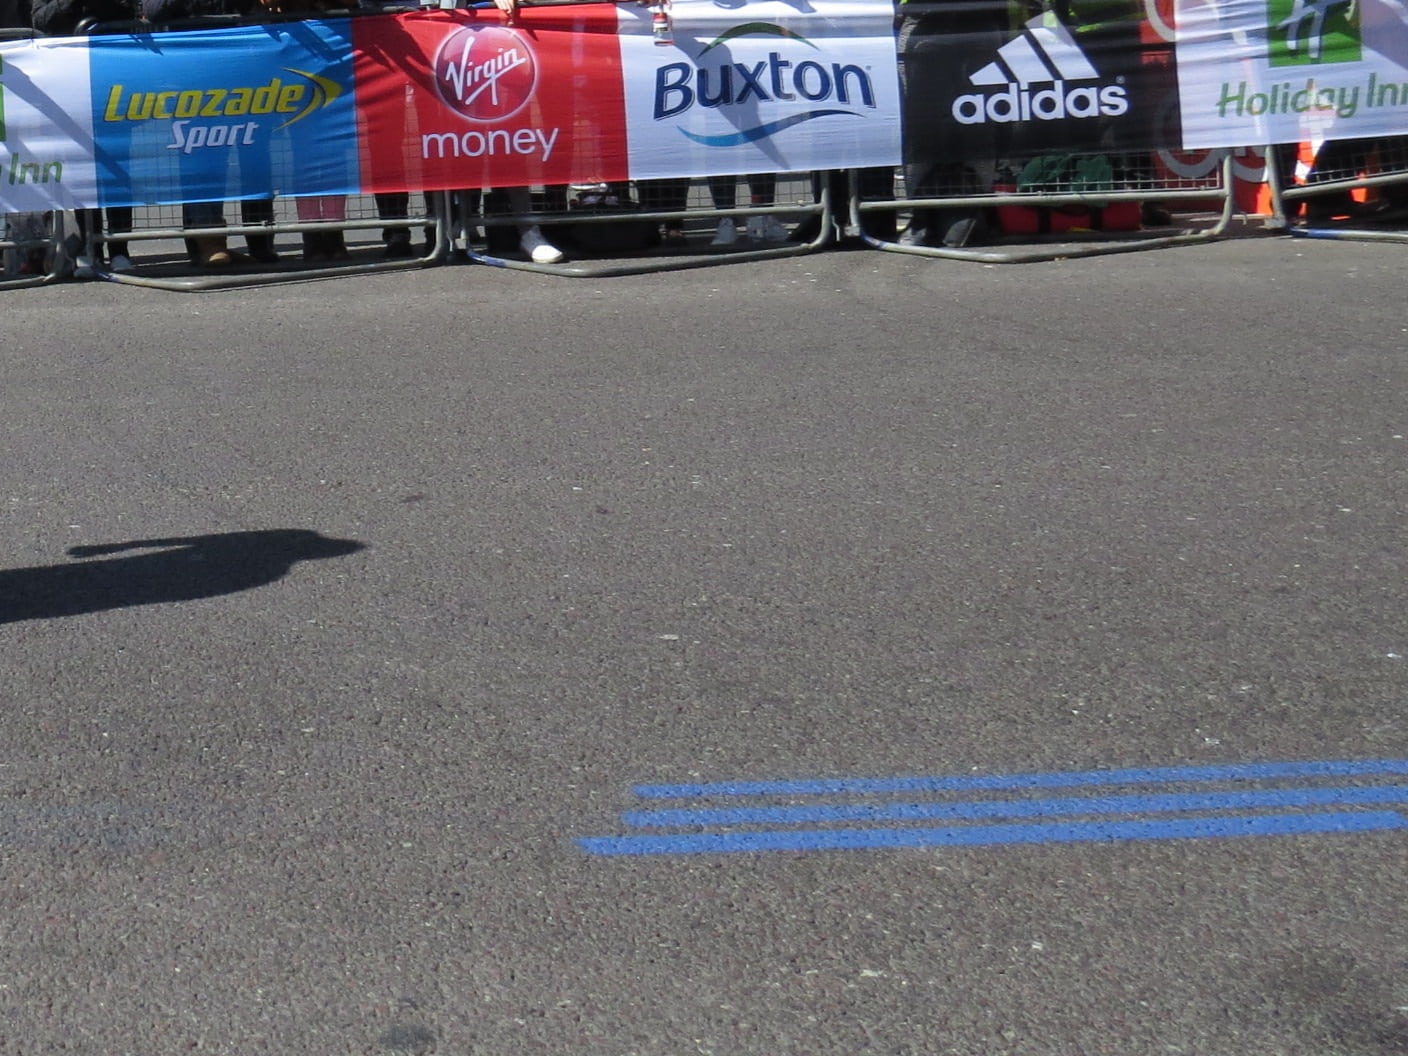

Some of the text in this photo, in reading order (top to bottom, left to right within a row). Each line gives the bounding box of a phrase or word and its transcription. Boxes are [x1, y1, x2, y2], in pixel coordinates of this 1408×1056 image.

[445, 36, 526, 106] Virgin
[653, 52, 876, 121] Buxton
[105, 78, 305, 122] Lucozade
[952, 80, 1129, 125] adidas
[1216, 77, 1360, 118] Holiday
[166, 120, 259, 154] Sport
[422, 127, 559, 162] money
[7, 152, 63, 185] Inn
